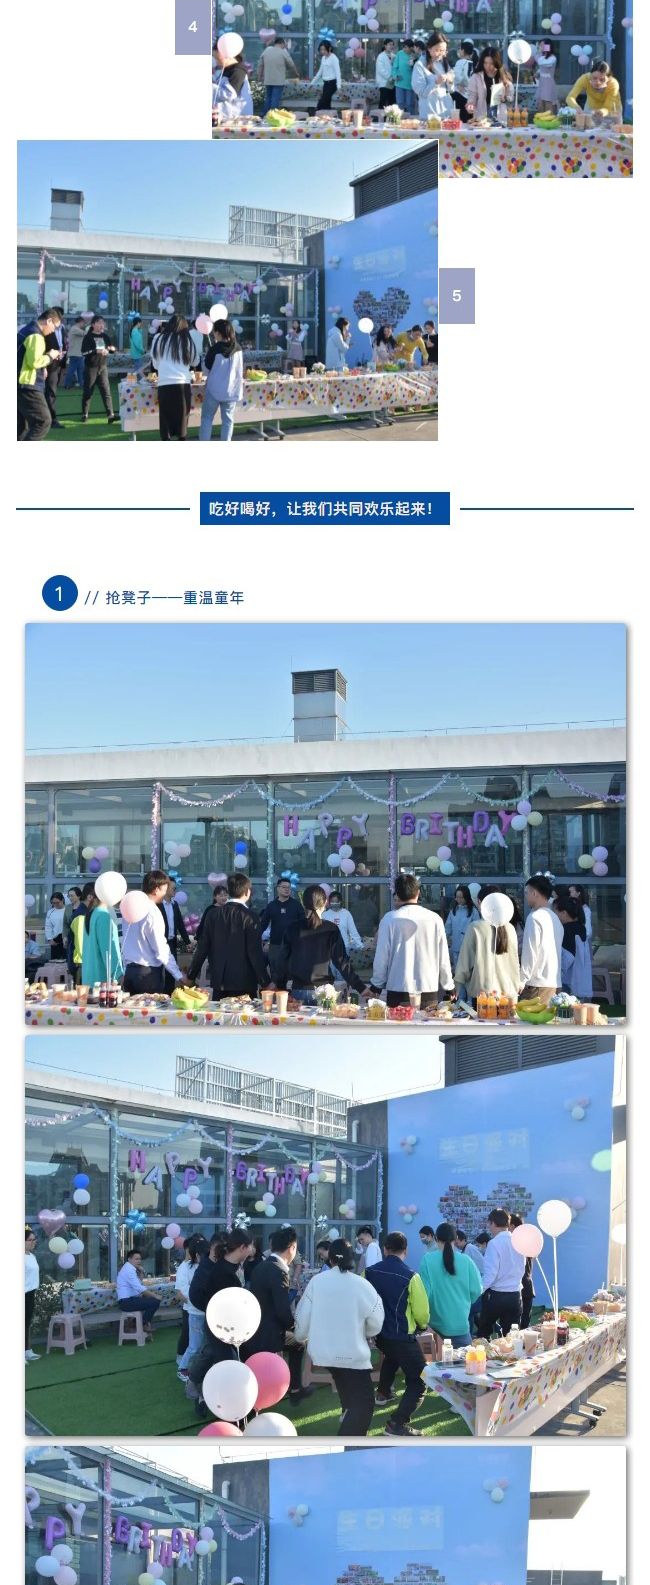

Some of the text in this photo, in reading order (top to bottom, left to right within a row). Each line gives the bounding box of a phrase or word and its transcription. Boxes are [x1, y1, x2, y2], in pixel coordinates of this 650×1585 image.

[284, 810, 516, 852] HAPPY BRITHDAY
[128, 1149, 212, 1192] HAPPY
